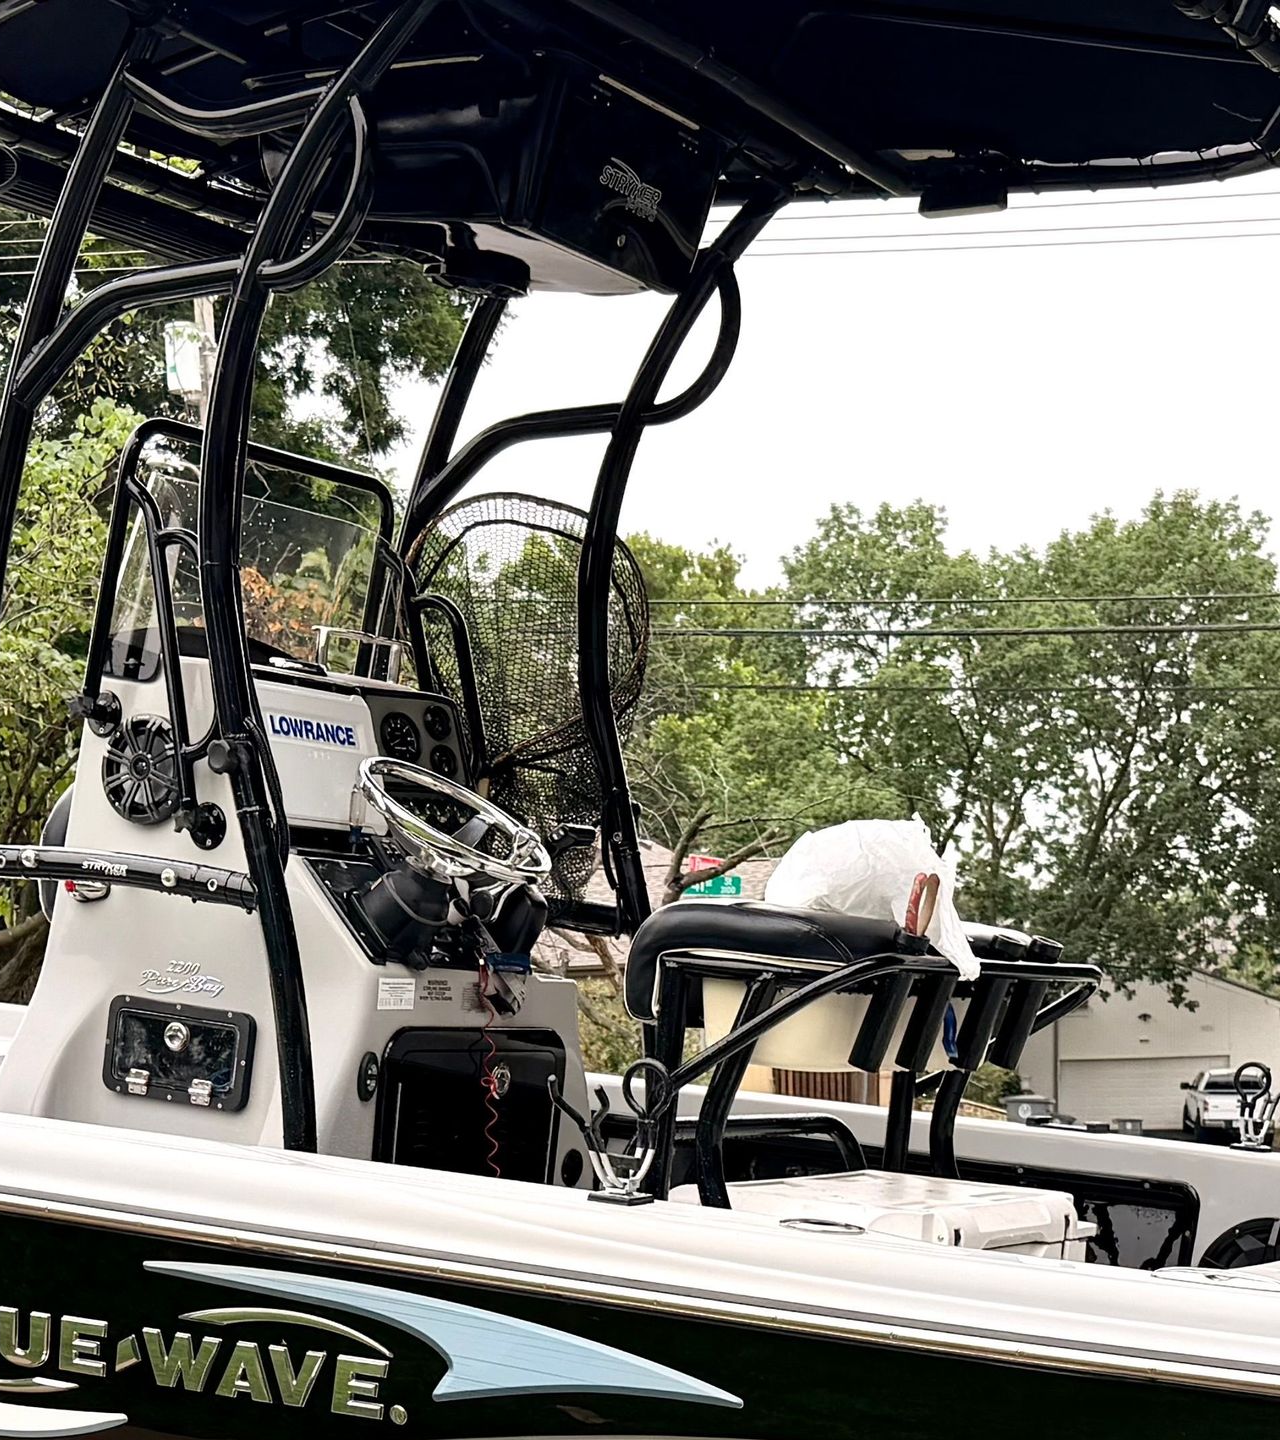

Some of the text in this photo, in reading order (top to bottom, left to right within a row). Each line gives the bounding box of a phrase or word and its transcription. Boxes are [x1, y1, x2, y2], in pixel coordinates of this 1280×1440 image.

[600, 165, 662, 209] STRYKER
[269, 714, 356, 746] LOWRANCE
[81, 860, 129, 872] STRYKER
[166, 959, 200, 987] 2200
[182, 974, 225, 998] Bay
